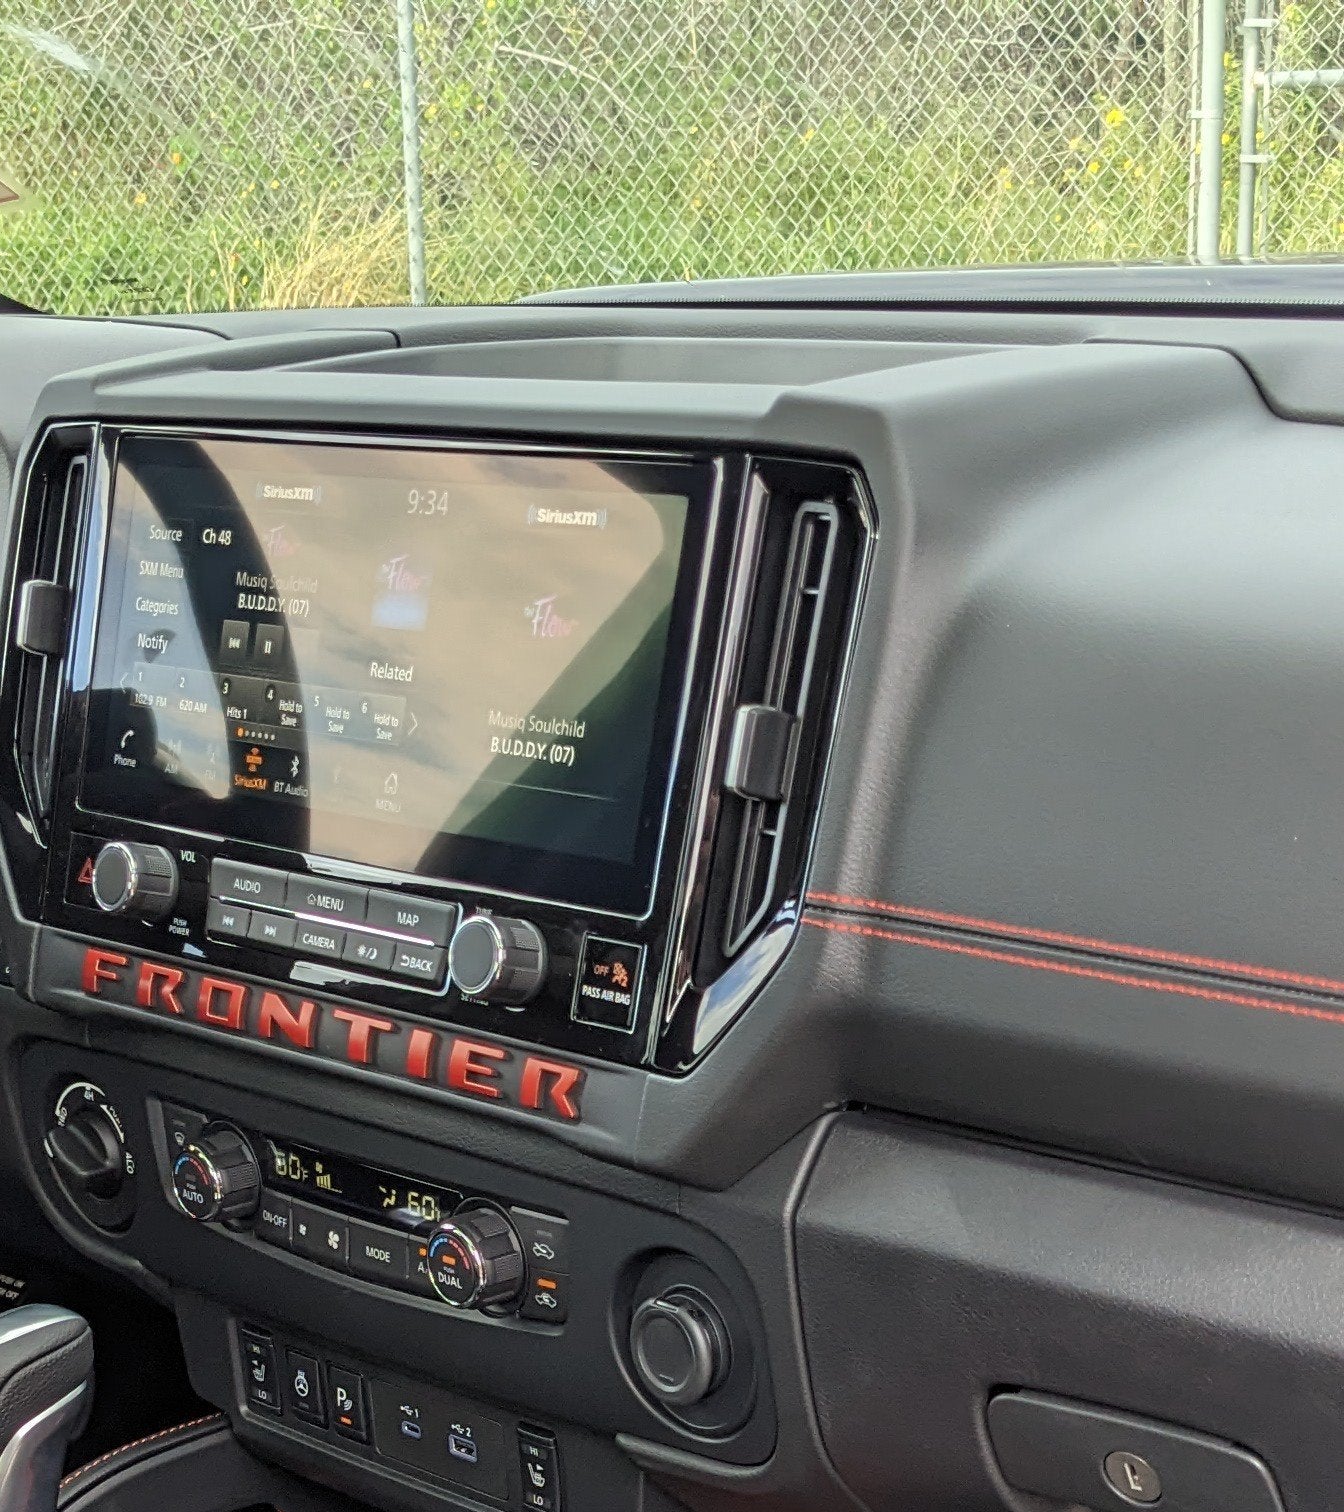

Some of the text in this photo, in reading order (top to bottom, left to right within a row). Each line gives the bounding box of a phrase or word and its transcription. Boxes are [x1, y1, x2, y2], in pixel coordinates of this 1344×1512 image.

[407, 489, 448, 515] 9:34
[150, 524, 183, 542] Source
[203, 528, 231, 546] Ch 48
[140, 560, 184, 579] SXM Menu
[236, 571, 268, 592] Musiq
[136, 596, 178, 617] Categories
[288, 598, 309, 618] (07)
[137, 632, 168, 654] Notify
[138, 672, 143, 682] 1
[370, 662, 414, 682] Related
[179, 676, 186, 688] 2
[223, 682, 229, 694] 3
[267, 689, 274, 700] 4
[314, 695, 320, 707] 5
[227, 706, 242, 718] Hits
[279, 699, 303, 713] Hold to
[326, 706, 350, 720] Hold to
[361, 701, 368, 714] 6
[281, 713, 297, 727] Save
[328, 720, 344, 734] Save
[374, 713, 399, 727] Hold to
[488, 710, 586, 738] Musiq Soulchild
[376, 727, 393, 741] Save
[491, 737, 575, 767] B.U.D.D.Y. (07)
[113, 753, 137, 768] Phone
[285, 783, 309, 797] Audio
[180, 849, 196, 863] VOL
[233, 878, 261, 893] AUDIO
[317, 895, 344, 911] MENU
[397, 911, 419, 927] MAP
[302, 933, 335, 950] CAMERA
[410, 957, 433, 972] BACK
[593, 964, 610, 976] OFF
[582, 984, 601, 998] PASS
[615, 992, 631, 1005] BAG
[82, 948, 582, 1119] FRONTIER
[182, 1188, 204, 1203] AUTO
[365, 1245, 391, 1263] MODE
[437, 1271, 463, 1290] DUAL
